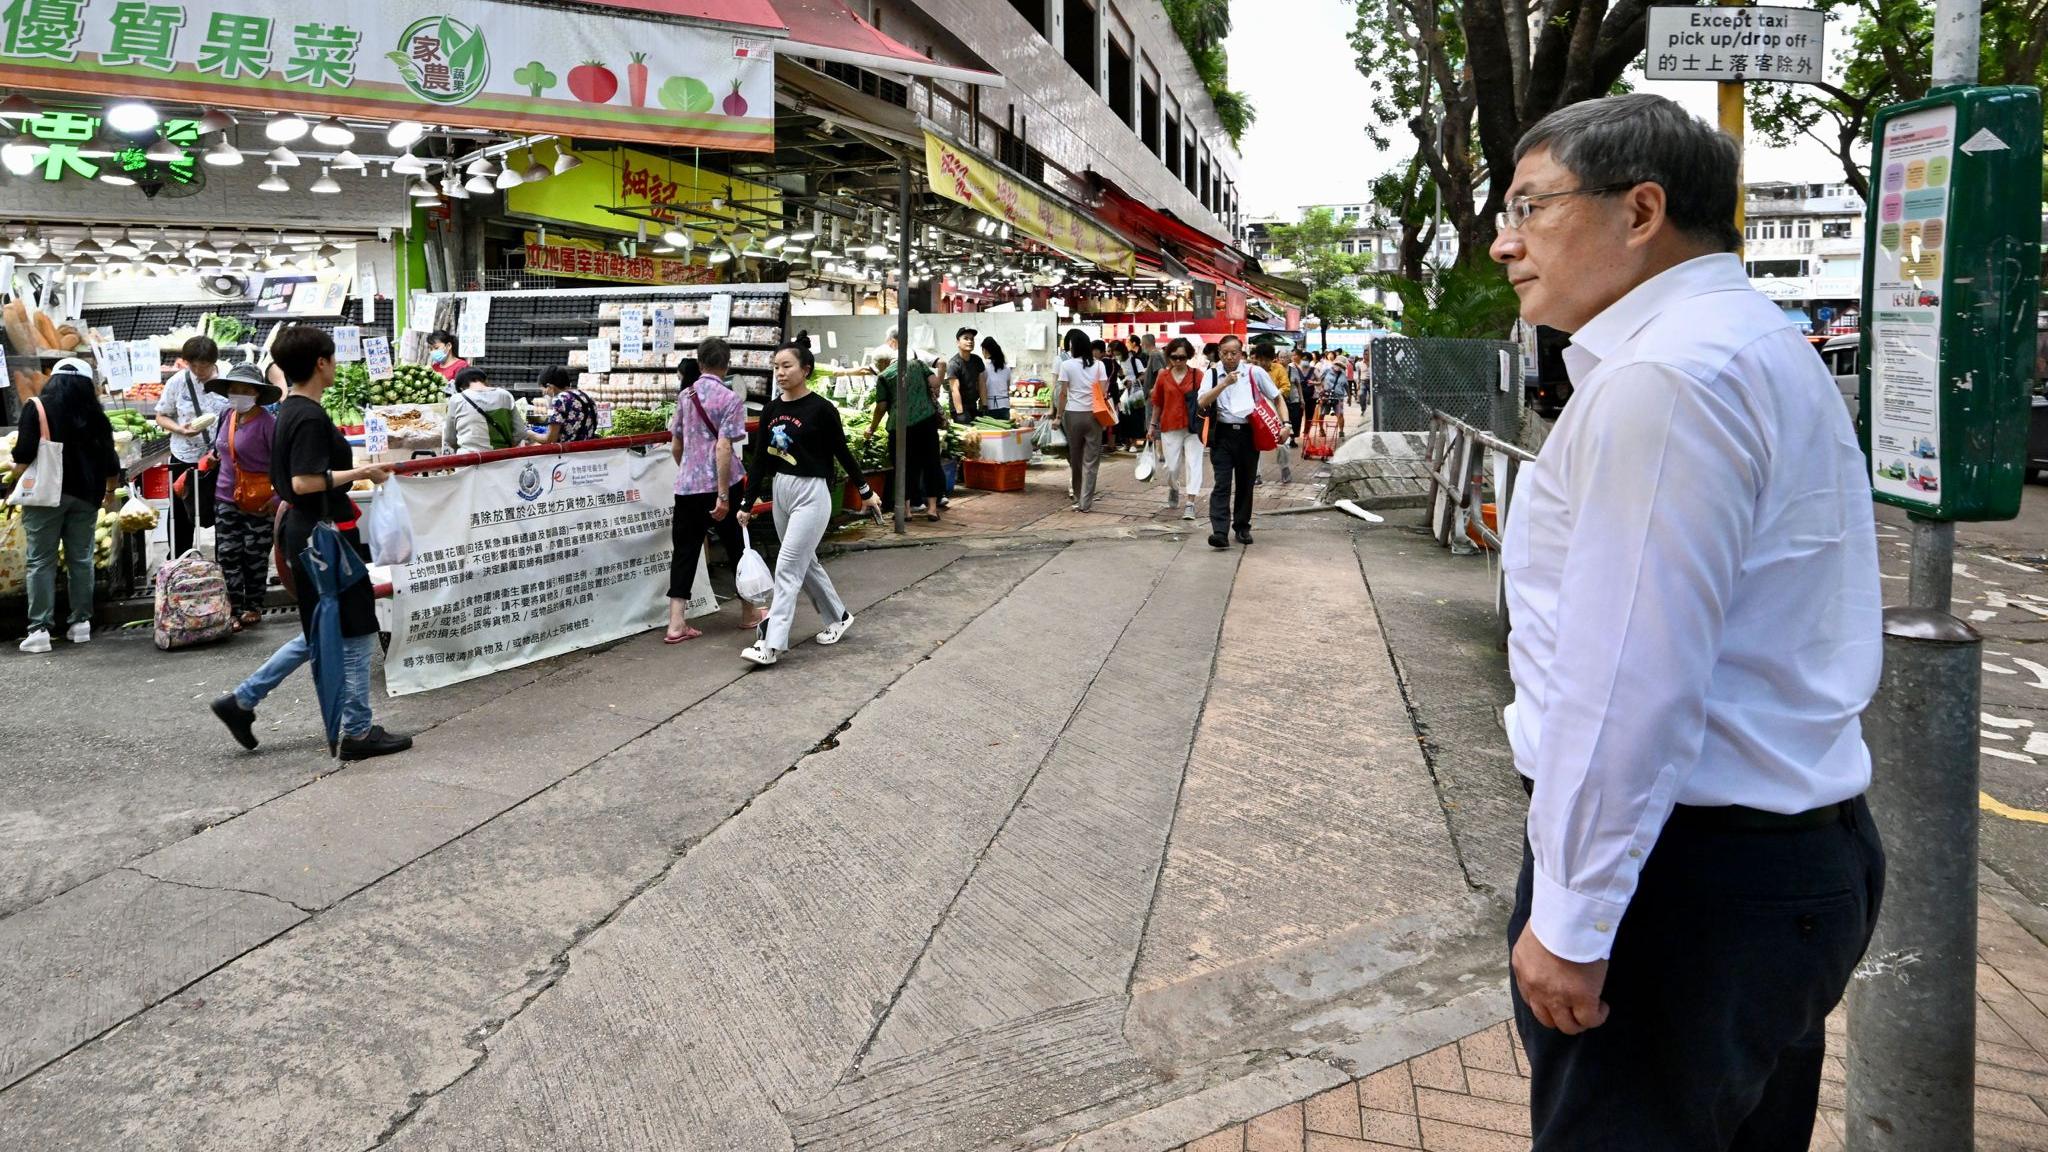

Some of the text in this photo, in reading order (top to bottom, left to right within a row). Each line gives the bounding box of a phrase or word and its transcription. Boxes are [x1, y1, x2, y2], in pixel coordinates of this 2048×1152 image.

[1690, 13, 1788, 30] Except taxi
[2, 0, 358, 87] 優質果菜
[1668, 31, 1807, 49] pick up/drop off
[1658, 54, 1813, 75] 的士上落客除外
